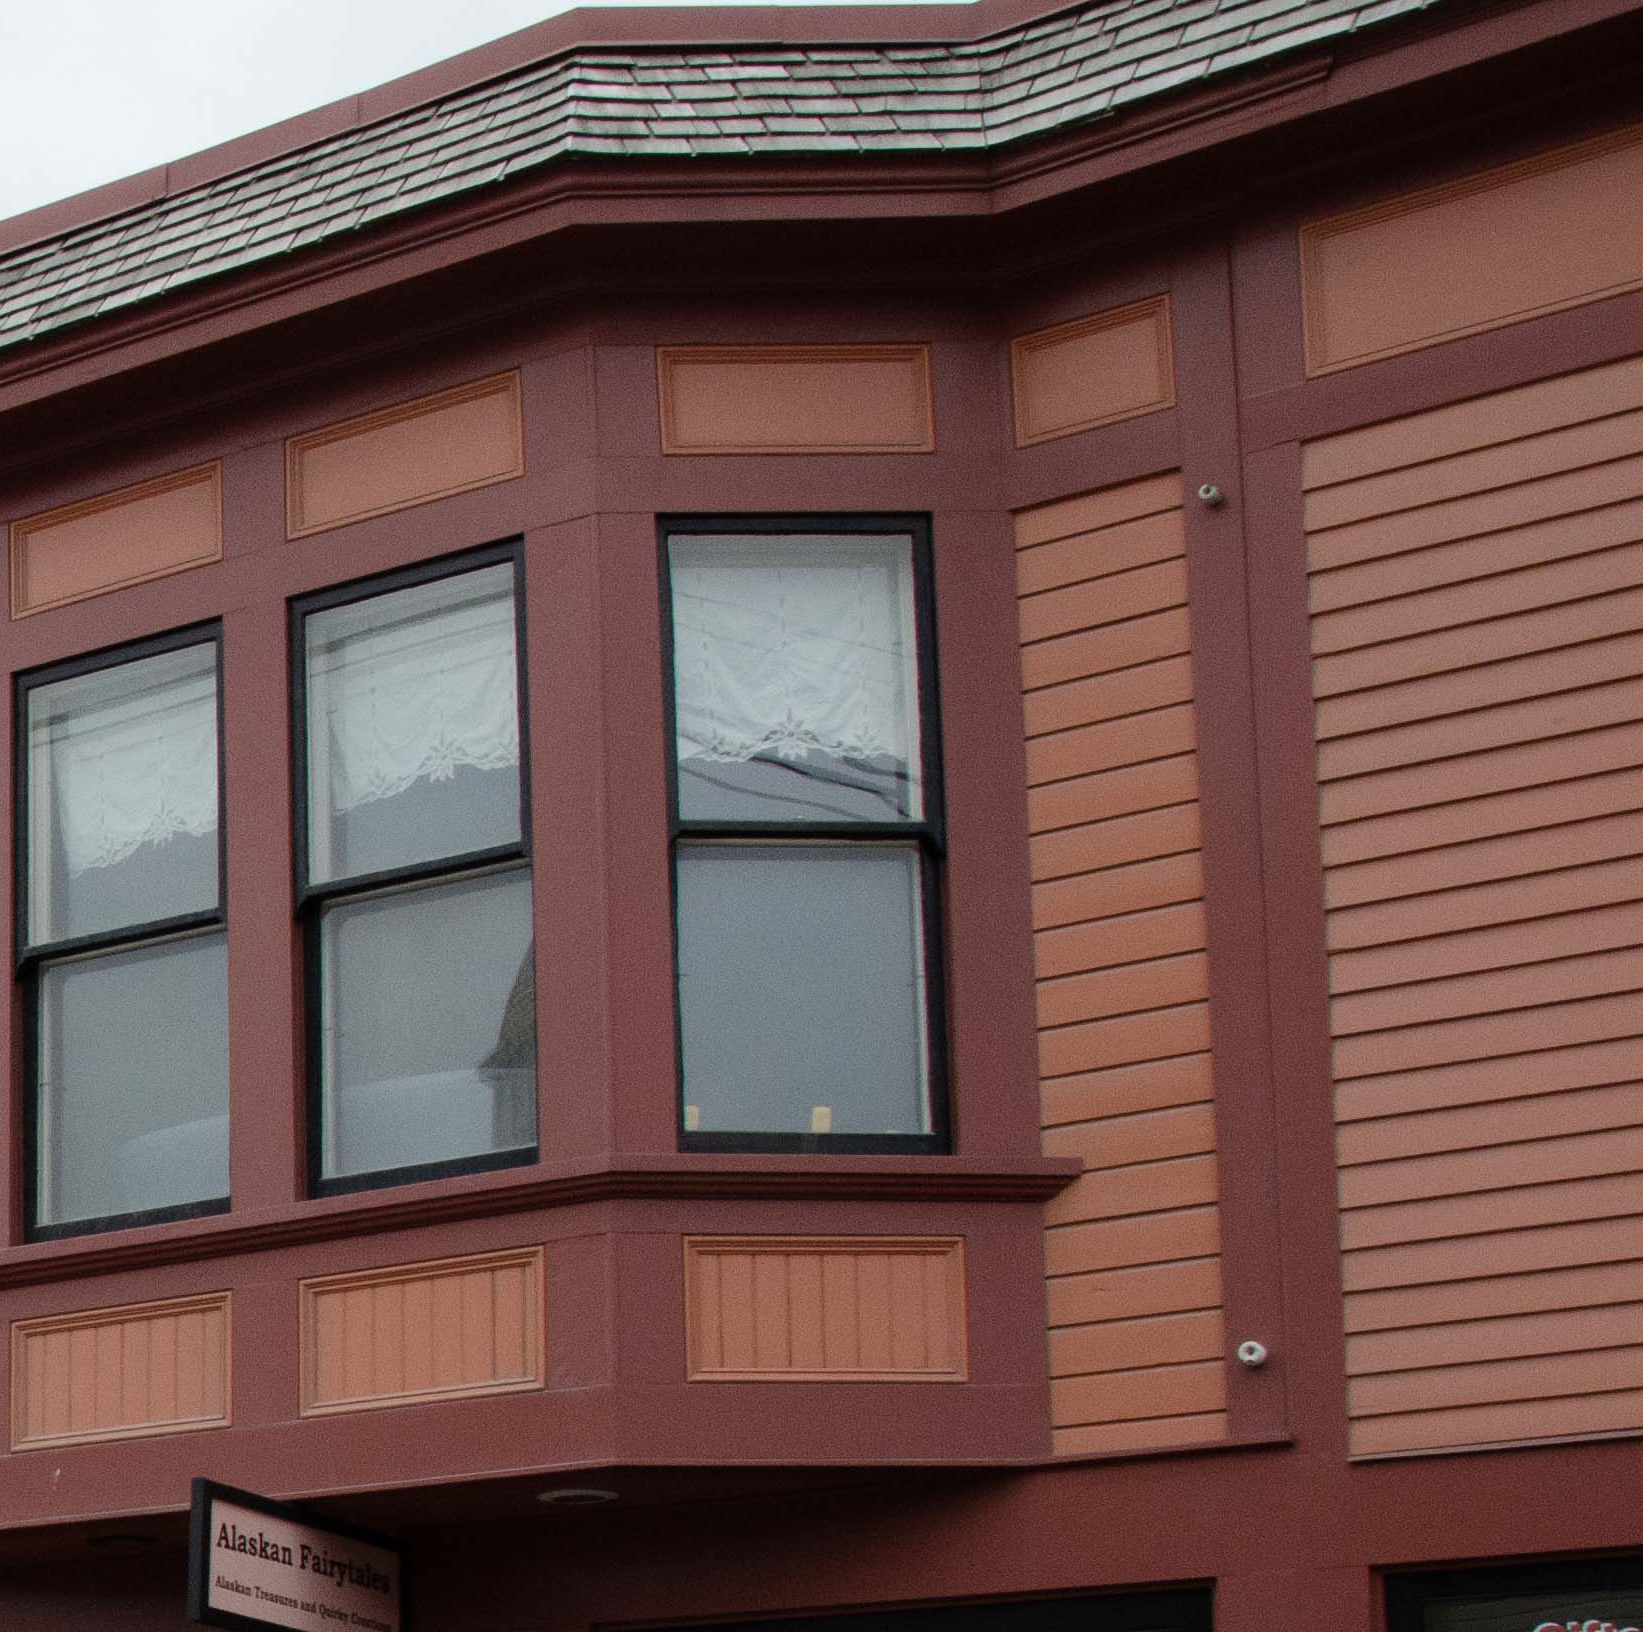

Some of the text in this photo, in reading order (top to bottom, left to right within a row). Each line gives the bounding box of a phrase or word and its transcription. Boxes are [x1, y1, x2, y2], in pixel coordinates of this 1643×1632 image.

[216, 1522, 390, 1593] Alaskan Fairytales
[215, 1575, 252, 1597] Alaskan
[254, 1586, 298, 1609] Treasures
[300, 1600, 317, 1614] and
